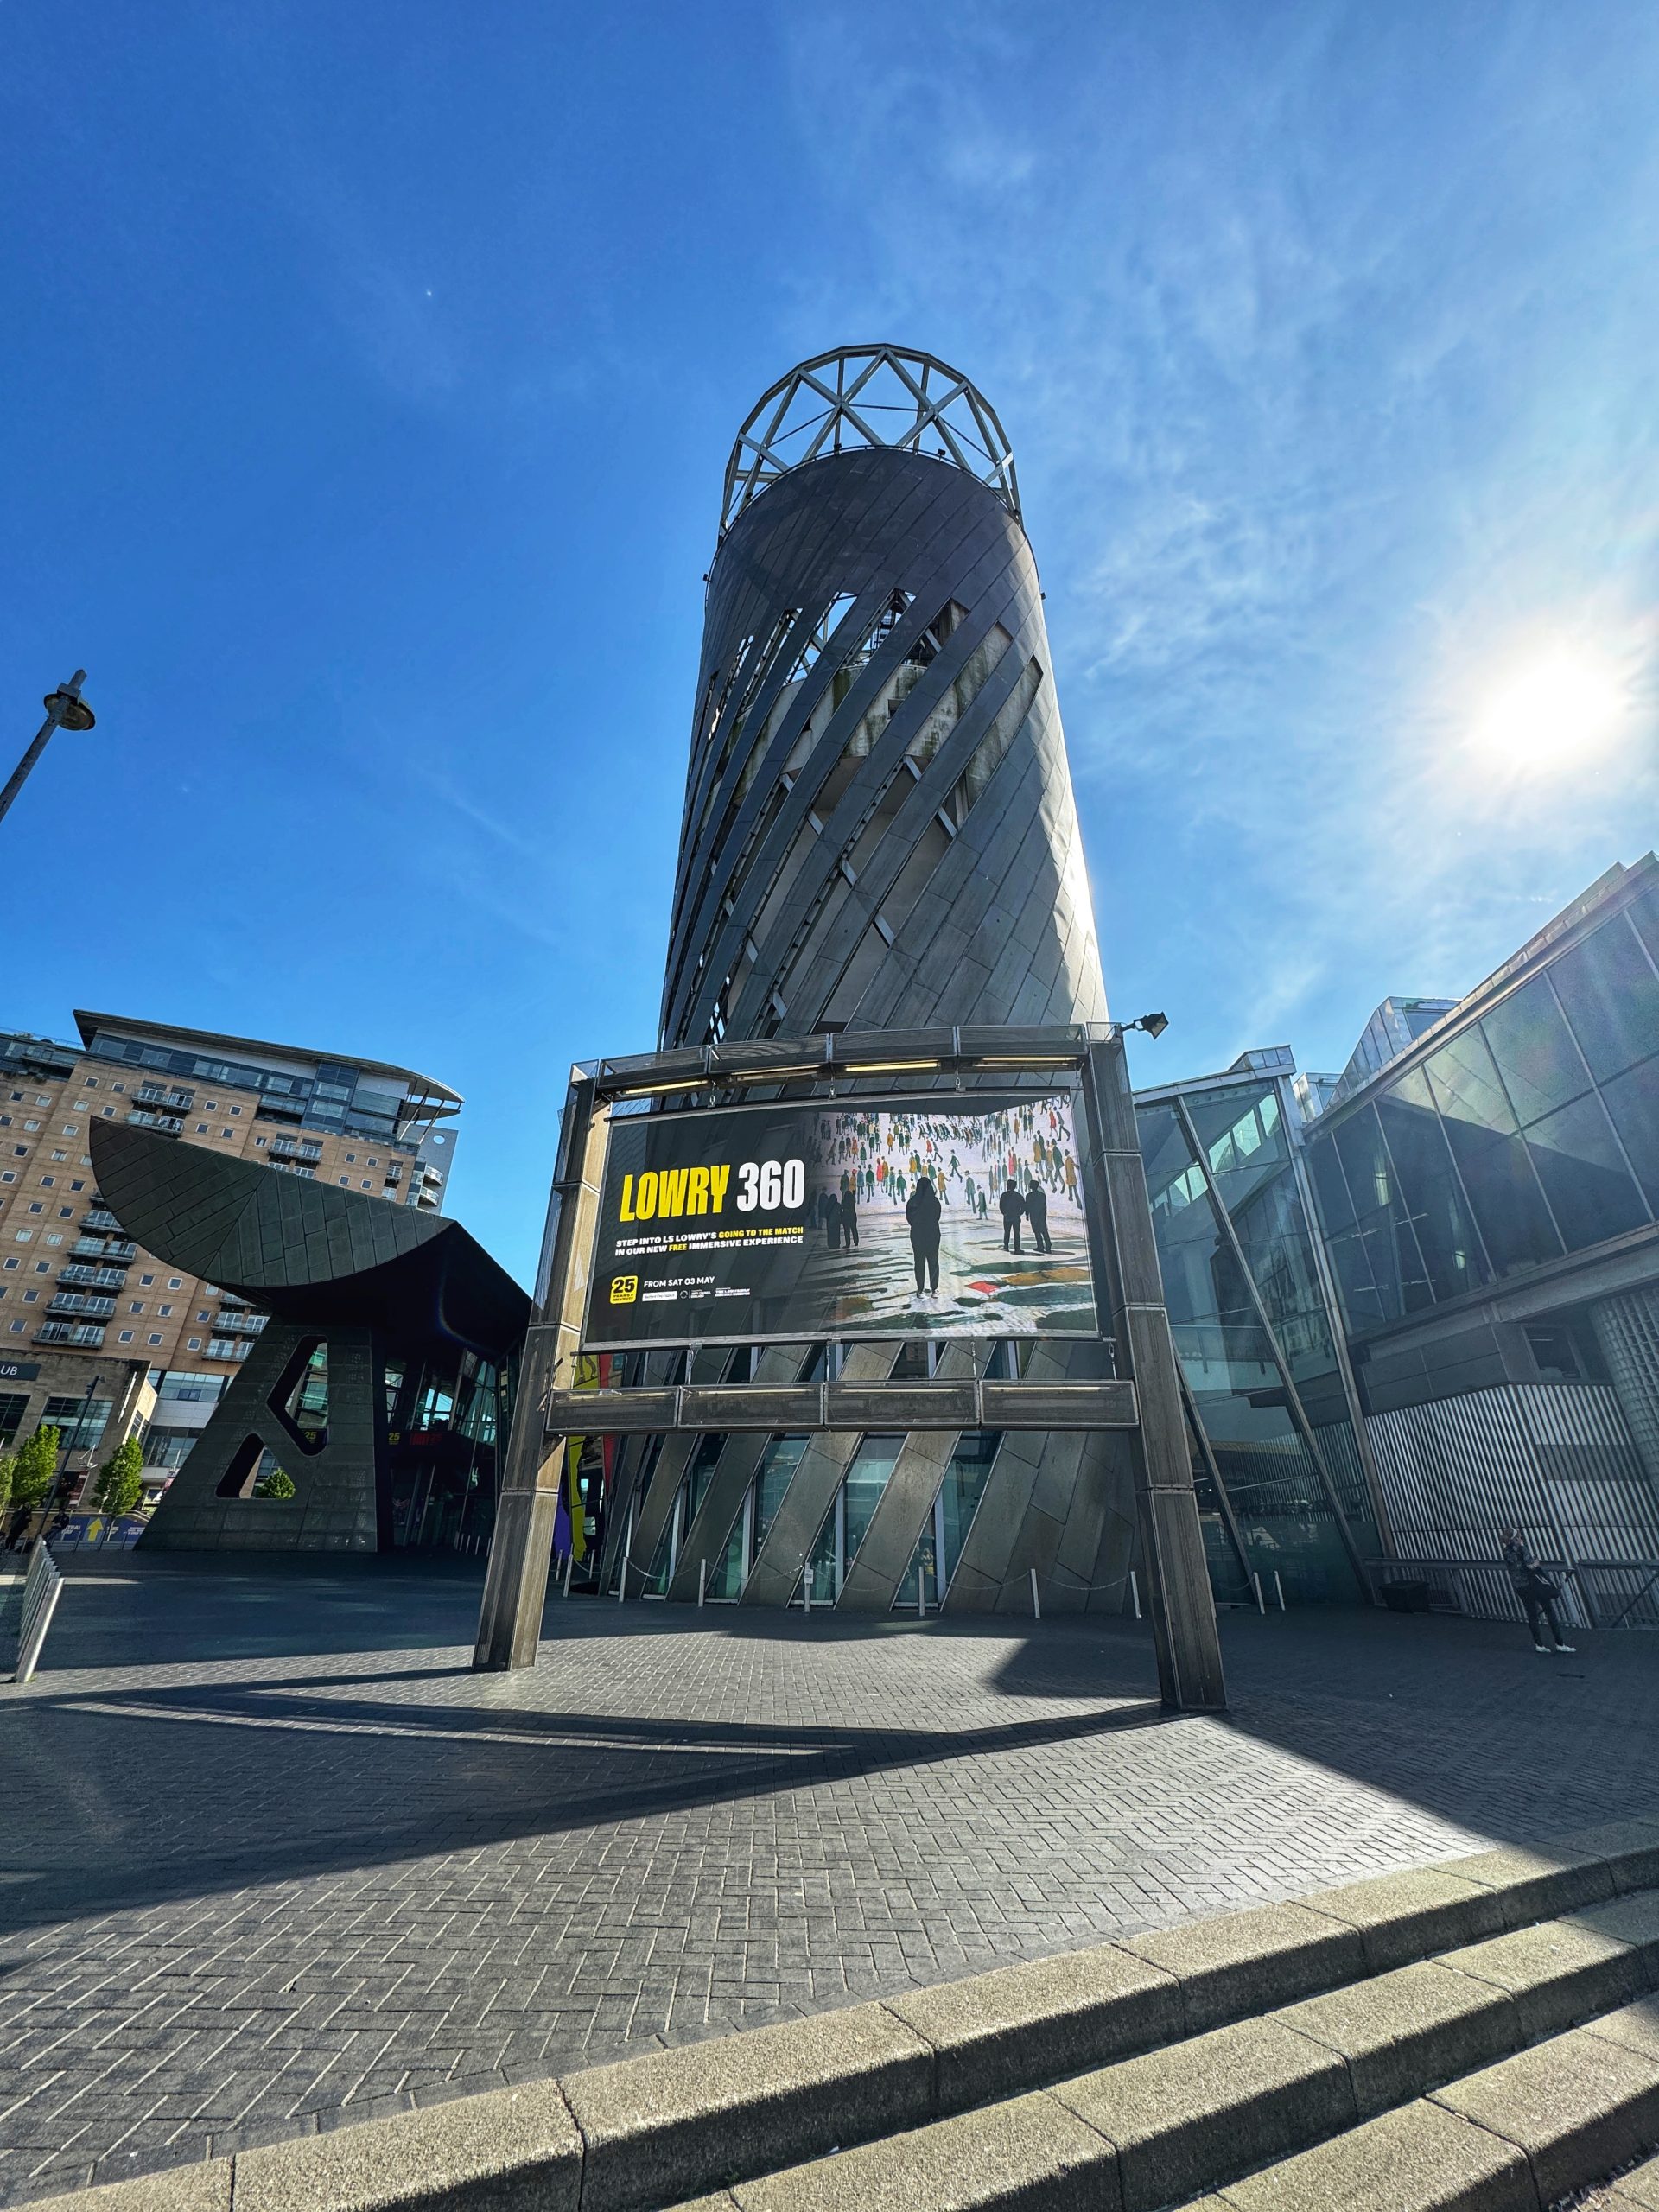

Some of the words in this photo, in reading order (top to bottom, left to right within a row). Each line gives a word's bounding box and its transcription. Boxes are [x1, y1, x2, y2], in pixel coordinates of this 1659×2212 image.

[620, 1165, 730, 1222] LOWRY
[736, 1159, 805, 1211] 360
[616, 1238, 639, 1247] STEP
[639, 1236, 661, 1245] INTO
[675, 1232, 717, 1242] LOWRY'S
[718, 1230, 744, 1238] GOING
[774, 1226, 804, 1235] MATCH
[689, 1239, 741, 1250] IMMERSIVE
[743, 1236, 804, 1246] EXPERIENCE
[613, 1278, 635, 1294] 25
[644, 1280, 666, 1288] FROM
[684, 1277, 696, 1286] 03
